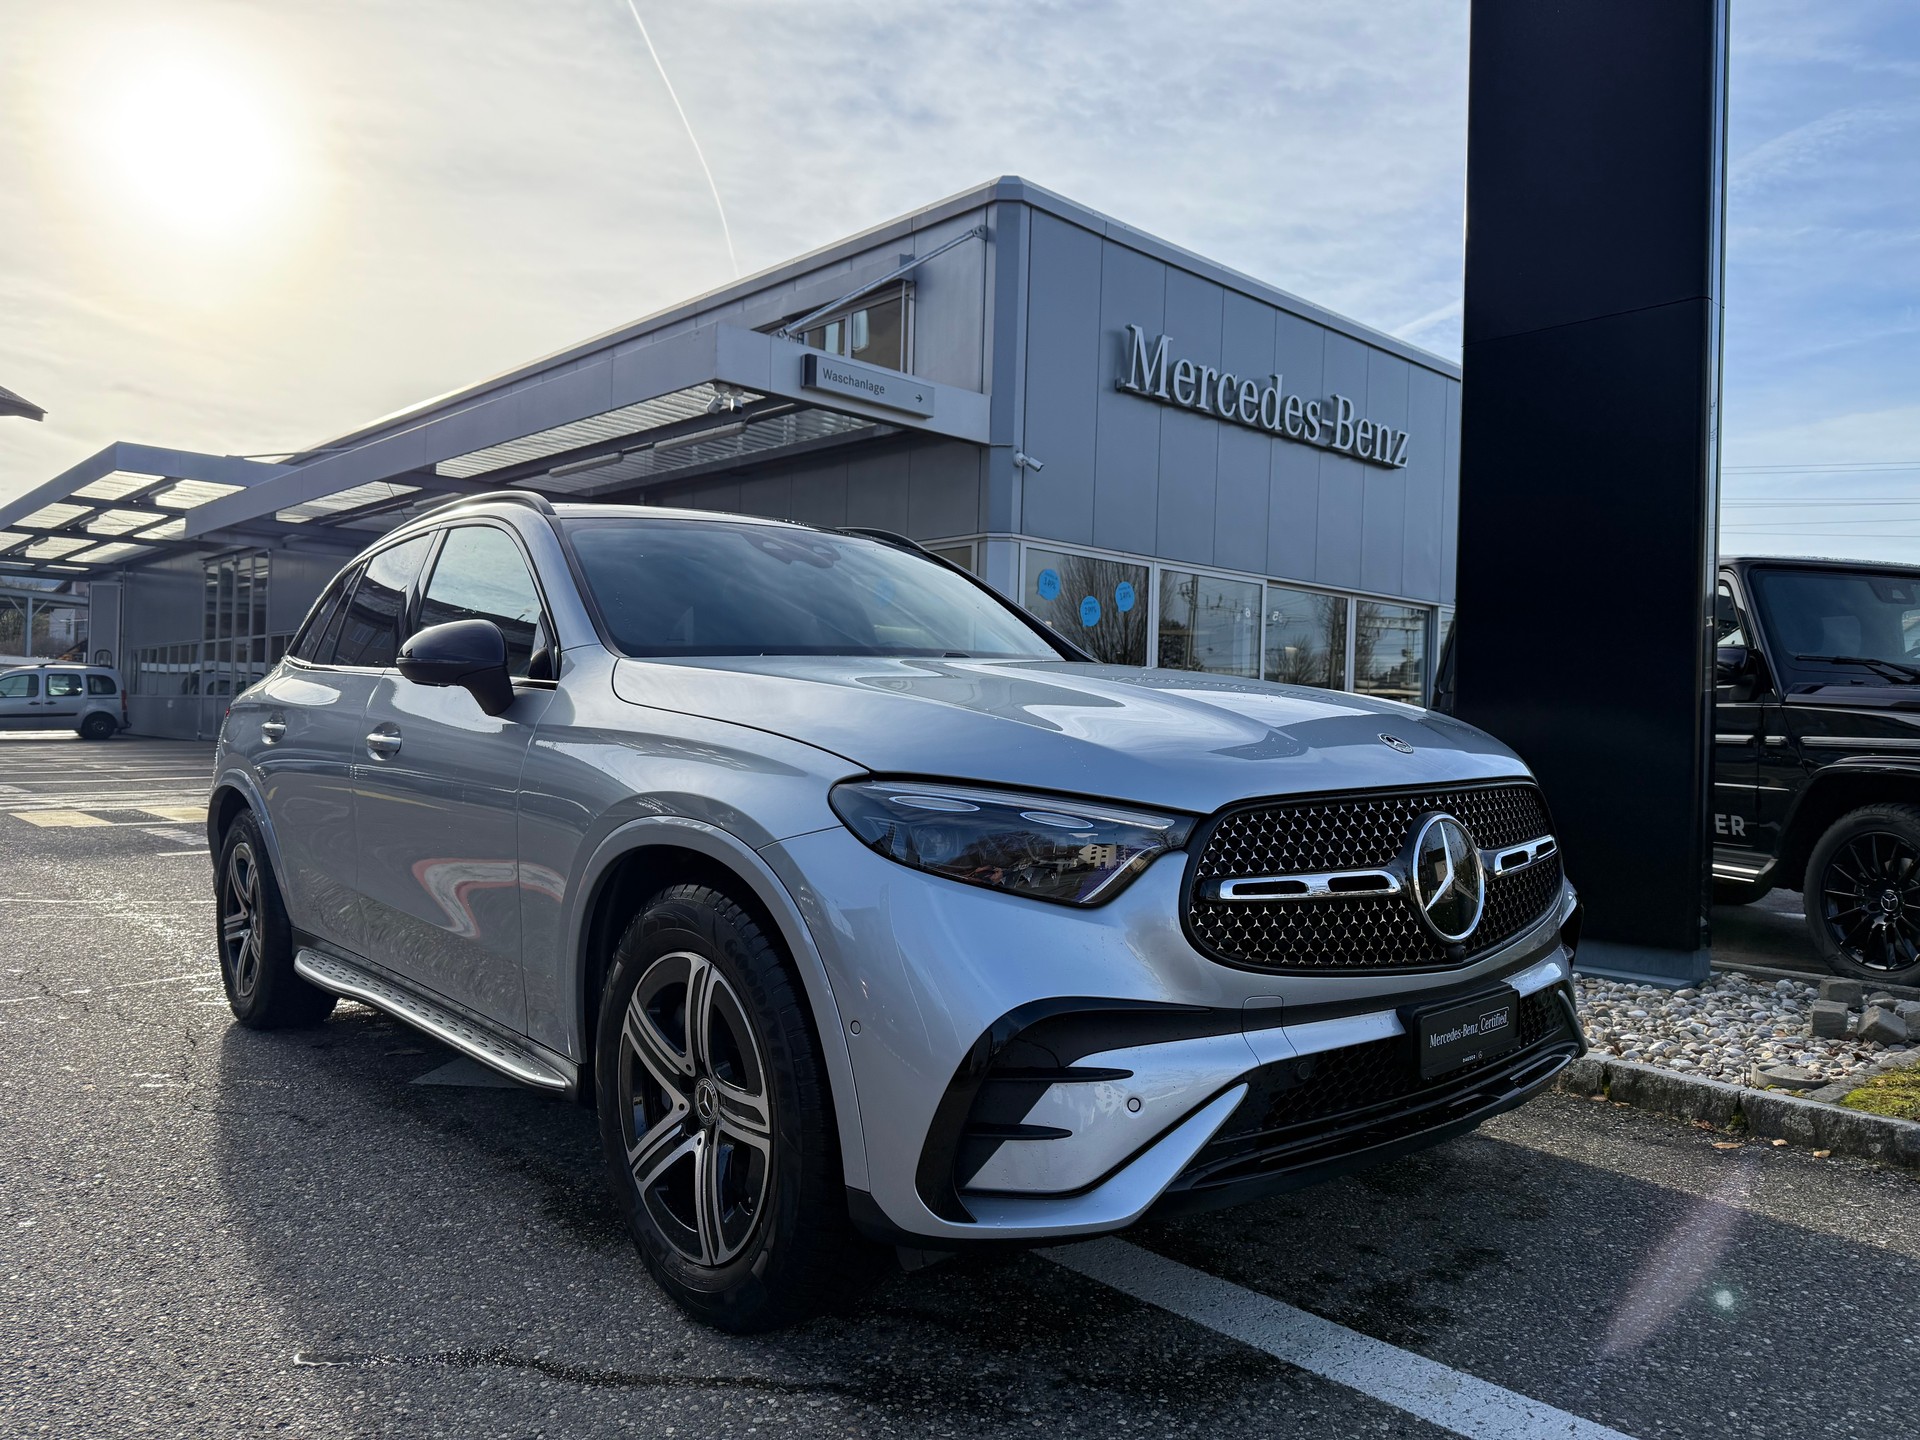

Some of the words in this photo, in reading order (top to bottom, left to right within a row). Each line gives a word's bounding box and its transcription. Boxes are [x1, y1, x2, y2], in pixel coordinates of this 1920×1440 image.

[822, 367, 886, 396] Waschanlage
[1124, 323, 1411, 468] Mercedes-Benz
[1429, 1022, 1479, 1048] Mercedes-Benz
[1480, 1011, 1507, 1031] Certified
